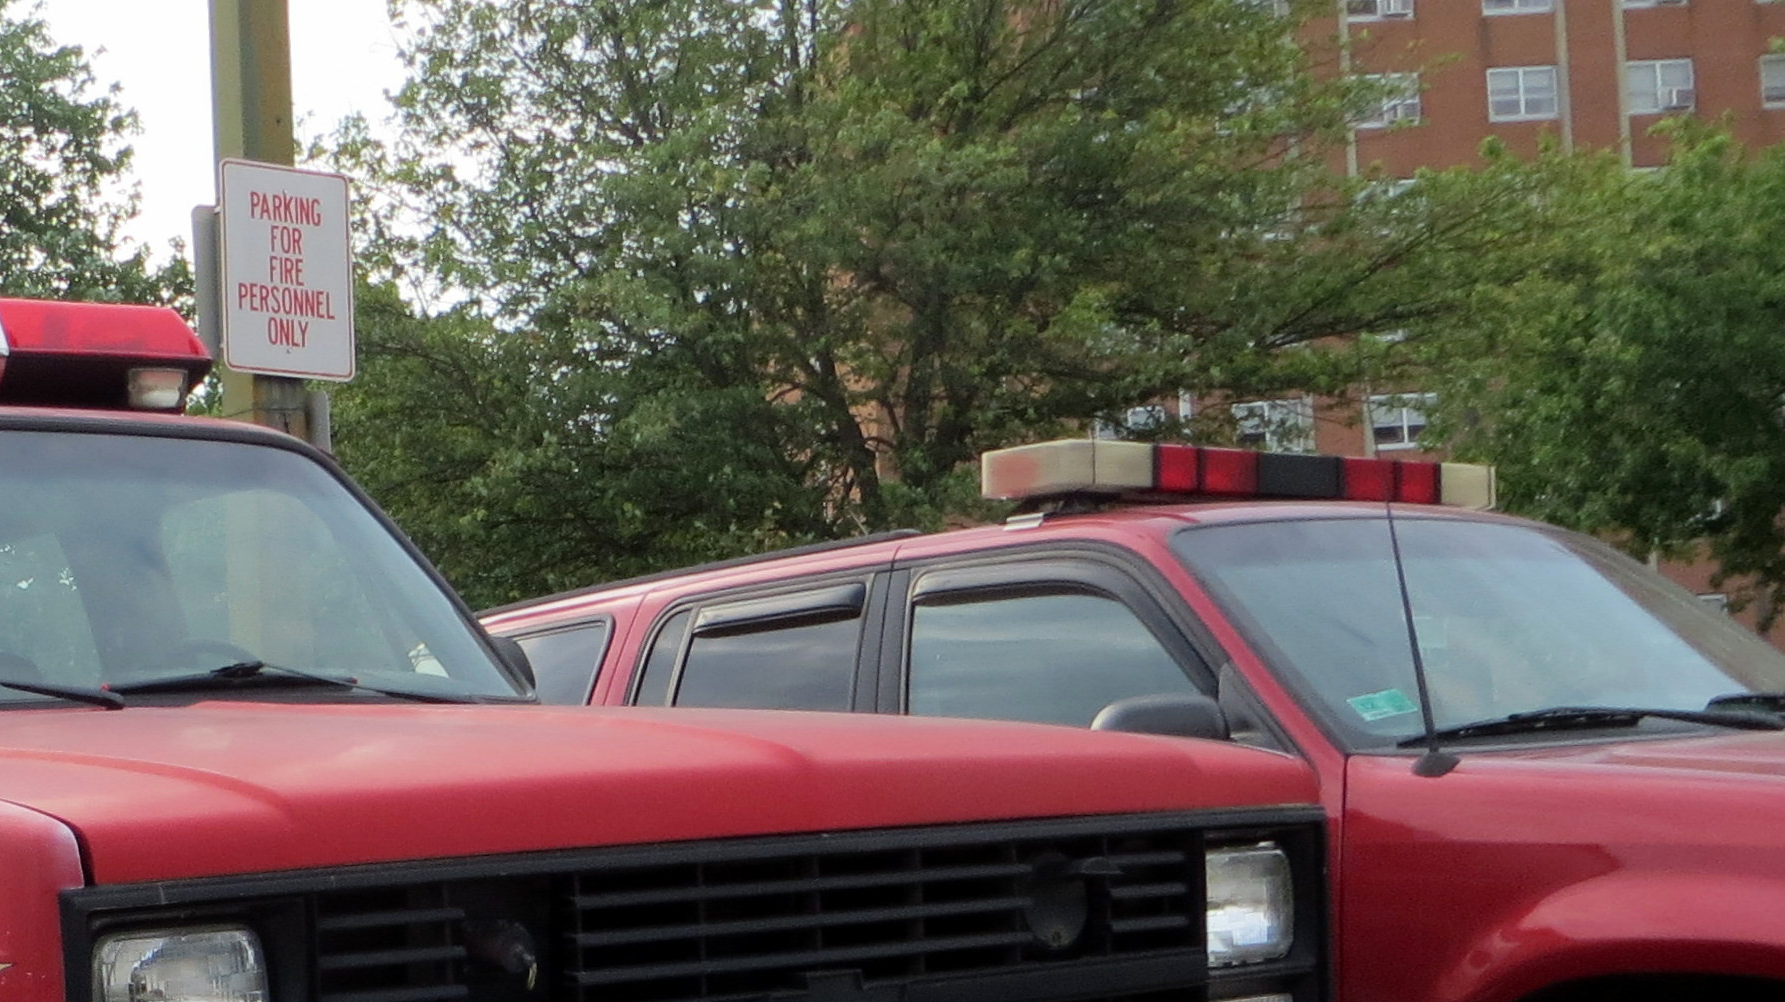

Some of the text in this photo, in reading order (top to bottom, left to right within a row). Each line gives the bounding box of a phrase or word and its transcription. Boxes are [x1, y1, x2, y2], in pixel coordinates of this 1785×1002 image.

[250, 191, 322, 227] PARKING
[270, 225, 302, 255] FOR
[269, 256, 305, 286] FIRE
[238, 283, 335, 320] PERSONNEL
[267, 317, 309, 347] ONLY
